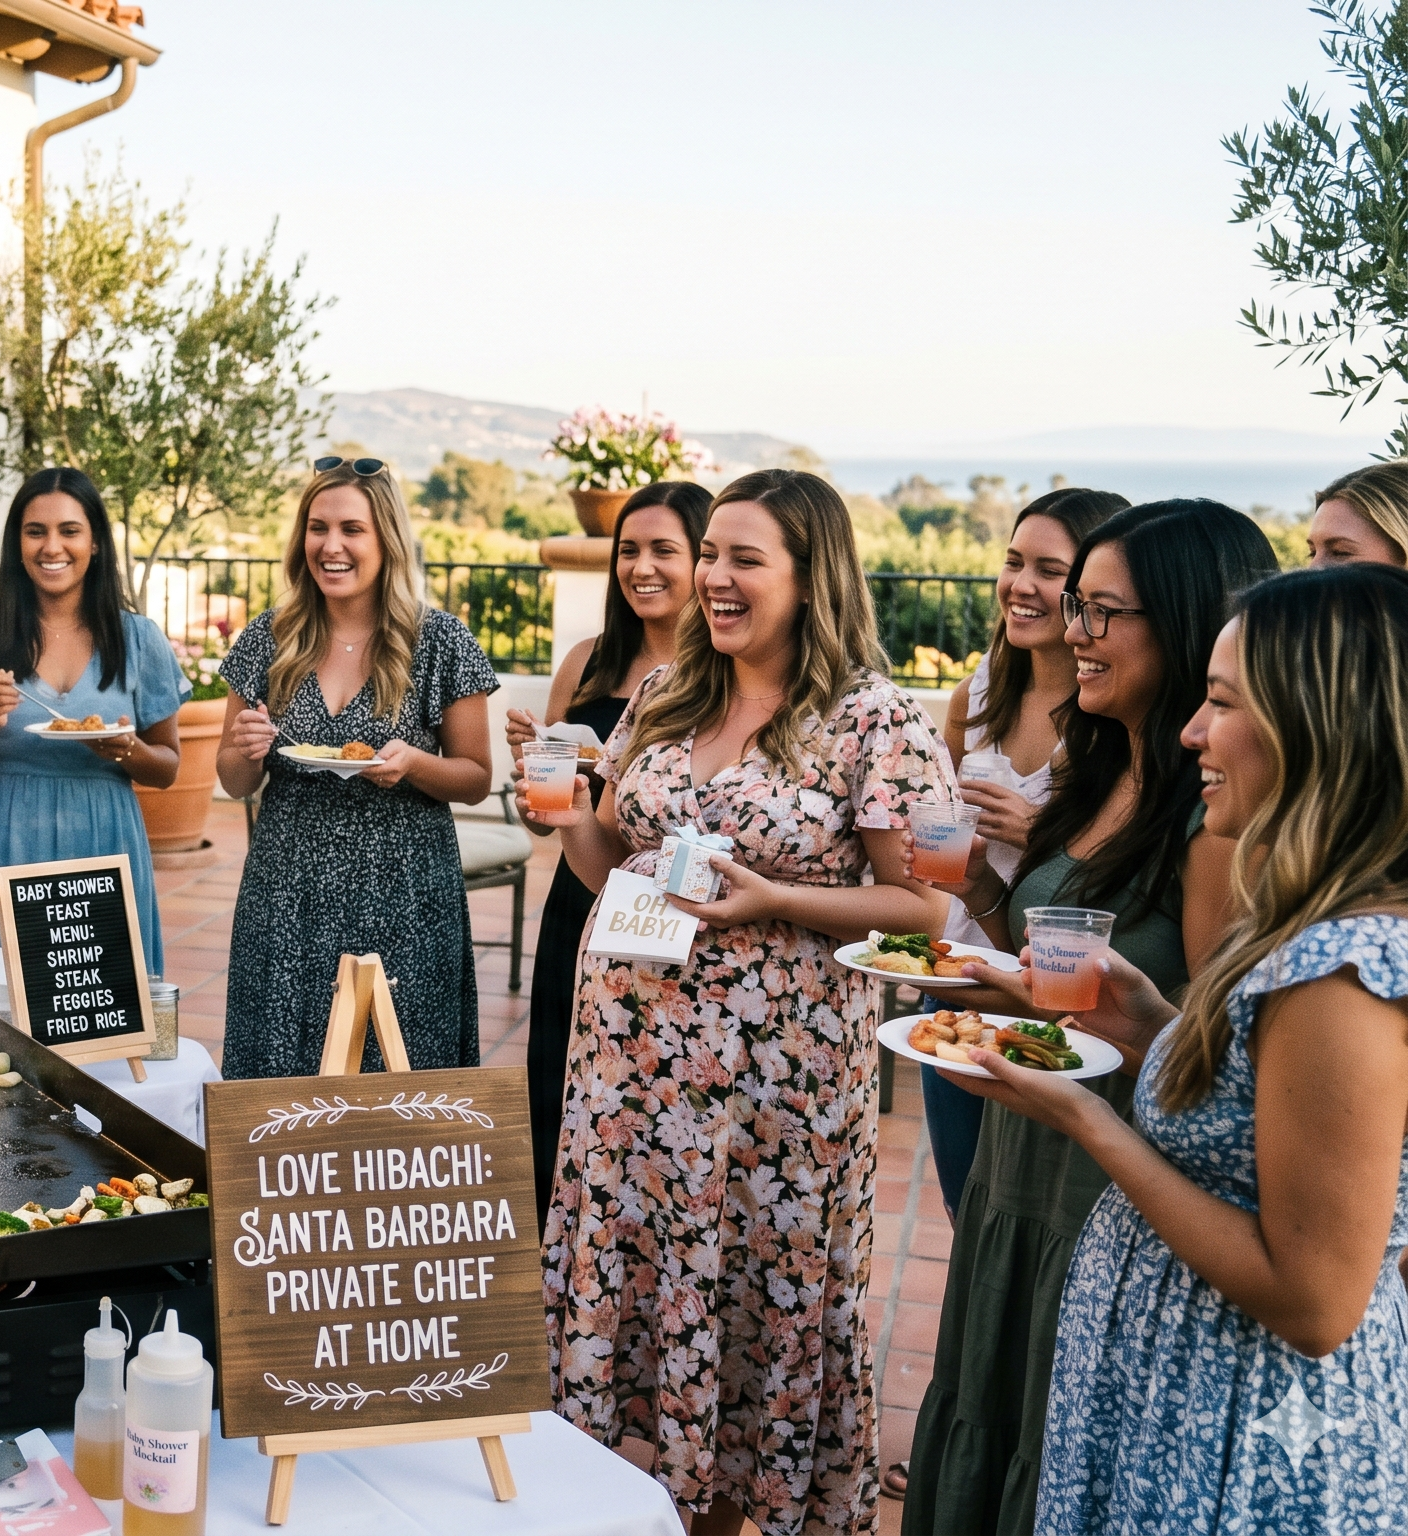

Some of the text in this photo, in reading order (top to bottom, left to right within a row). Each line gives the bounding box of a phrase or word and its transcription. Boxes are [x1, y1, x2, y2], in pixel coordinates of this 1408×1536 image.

[16, 876, 115, 902] BABY SHOWER
[45, 901, 91, 922] FEAST
[633, 893, 670, 916] OH
[49, 924, 95, 944] MENU:
[608, 910, 681, 942] BABY!
[46, 945, 103, 968] SHRIMP
[55, 968, 102, 989] STEAK
[52, 989, 114, 1012] FEGGIES
[46, 1009, 127, 1036] FRIED RICE
[258, 1143, 493, 1198] LOVE HIBACHI:
[233, 1198, 517, 1267] SANTA BARBARA
[266, 1256, 495, 1314] PRIVATE CHEF
[314, 1315, 461, 1369] AT HOME
[133, 1445, 177, 1464] Mocktail
[148, 1438, 189, 1450] Shower
